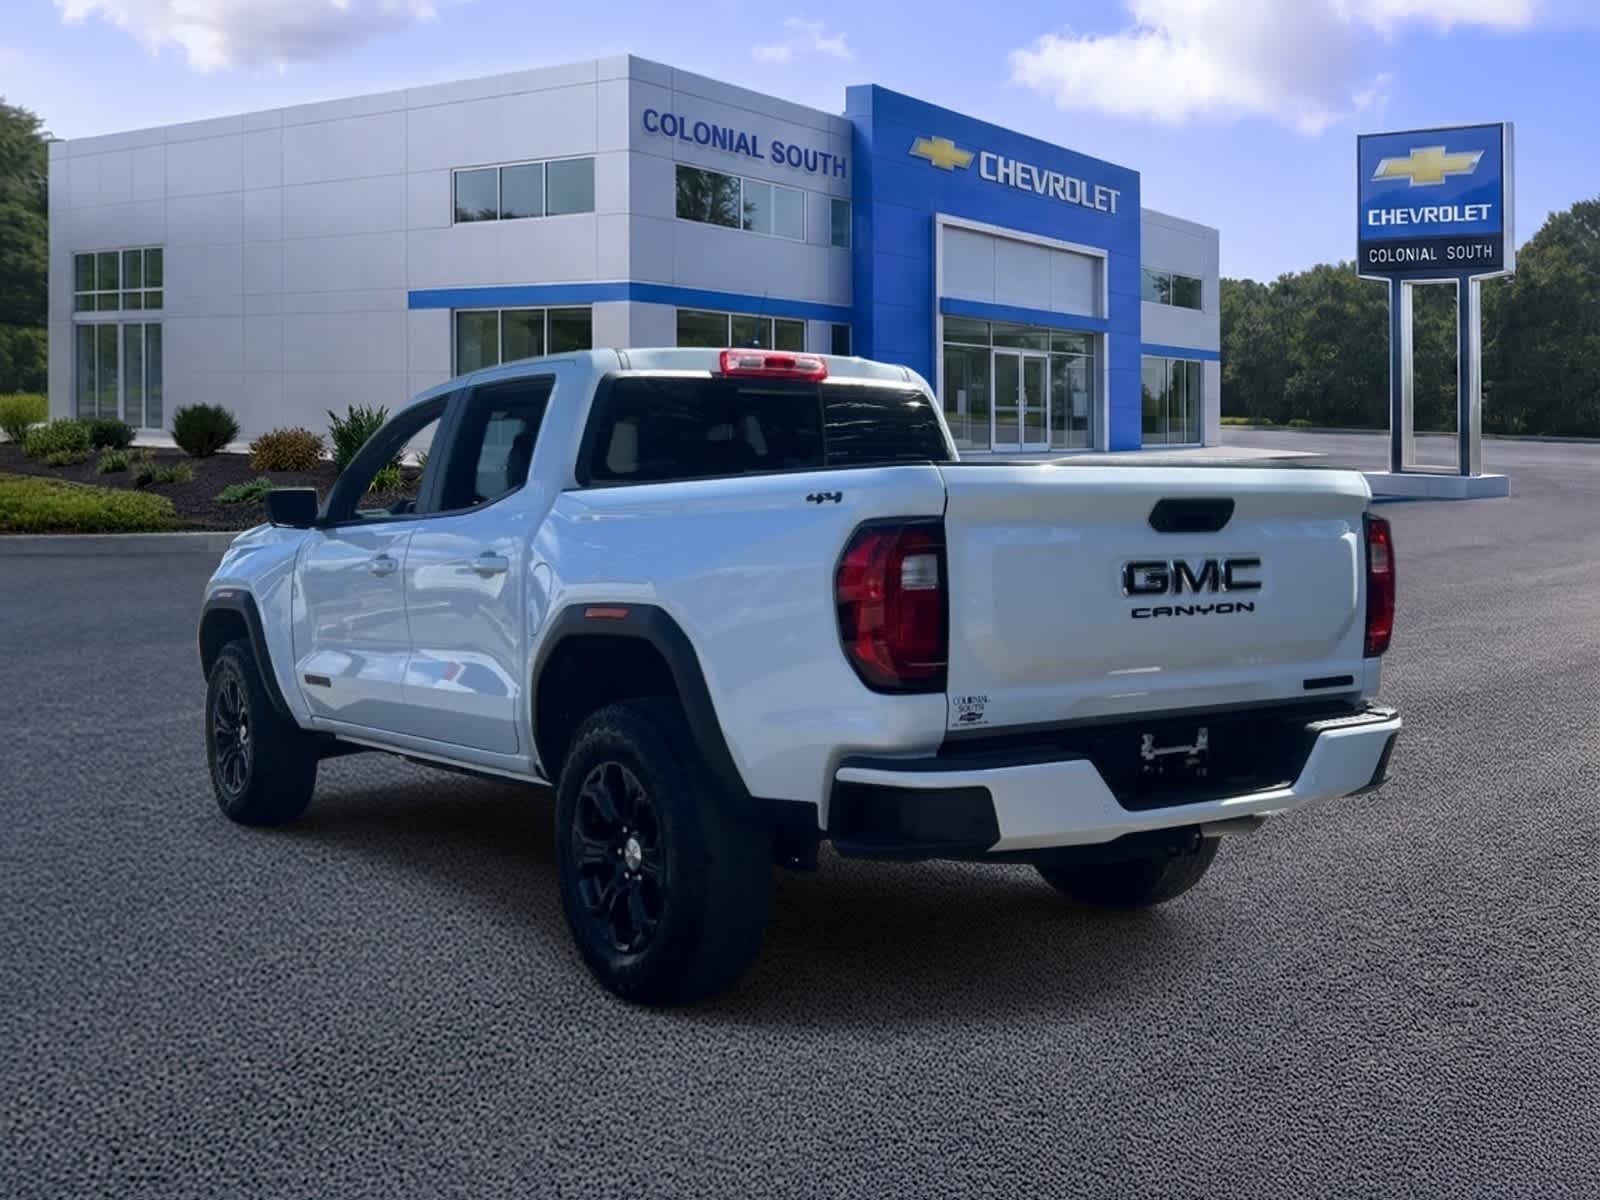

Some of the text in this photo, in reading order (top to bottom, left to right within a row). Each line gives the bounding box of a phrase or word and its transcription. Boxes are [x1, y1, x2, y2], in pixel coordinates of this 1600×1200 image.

[643, 108, 847, 179] COLONIAL SOUTH
[979, 151, 1121, 214] CHEVROLET
[1367, 204, 1492, 226] CHEVROLET
[1368, 244, 1493, 263] COLONIAL SOUTH
[1122, 557, 1263, 597] GMC
[1131, 602, 1255, 619] CANYON
